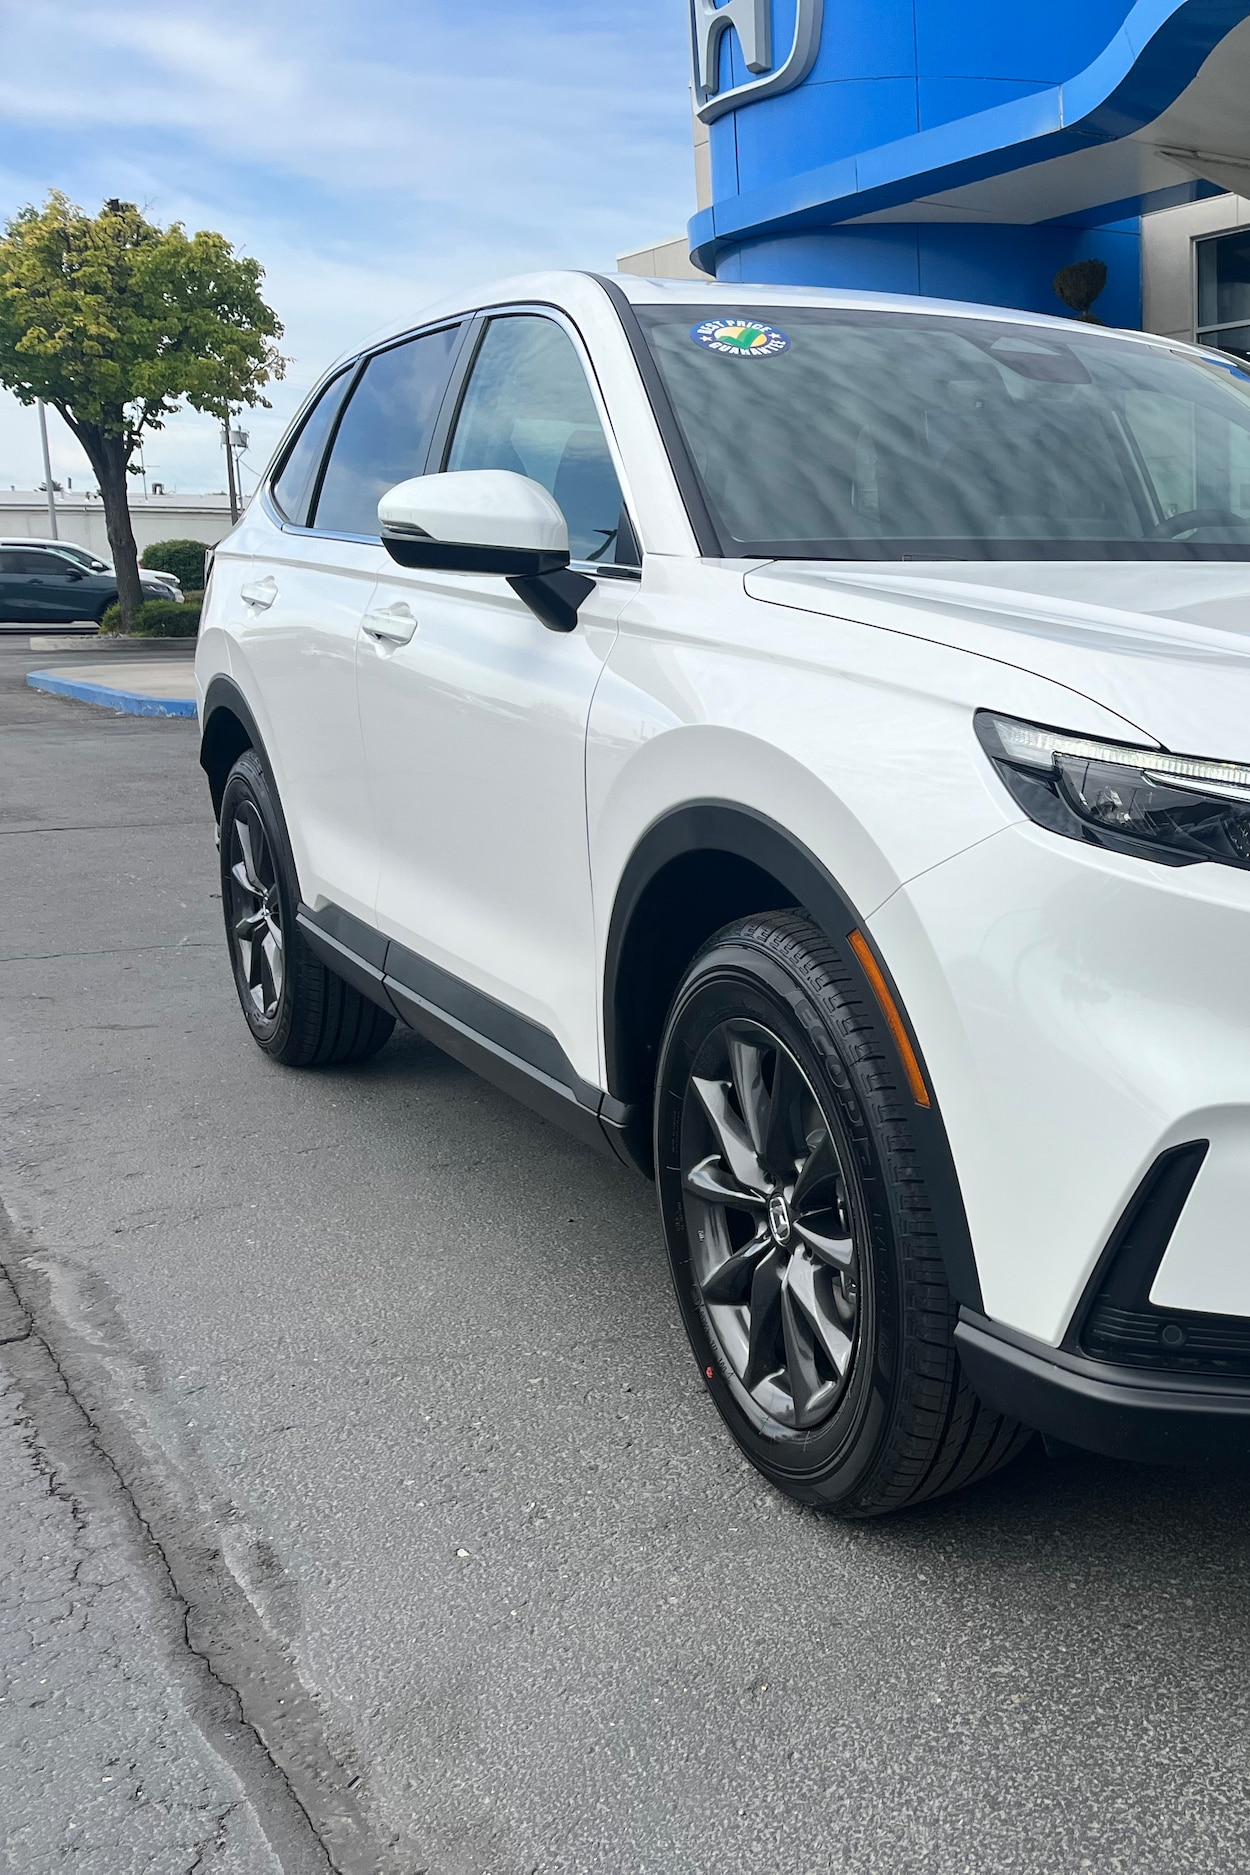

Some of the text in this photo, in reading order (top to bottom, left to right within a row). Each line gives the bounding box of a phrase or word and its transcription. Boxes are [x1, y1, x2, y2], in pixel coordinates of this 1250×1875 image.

[698, 320, 772, 335] BEST PRICE
[709, 340, 786, 355] GUARANTEE
